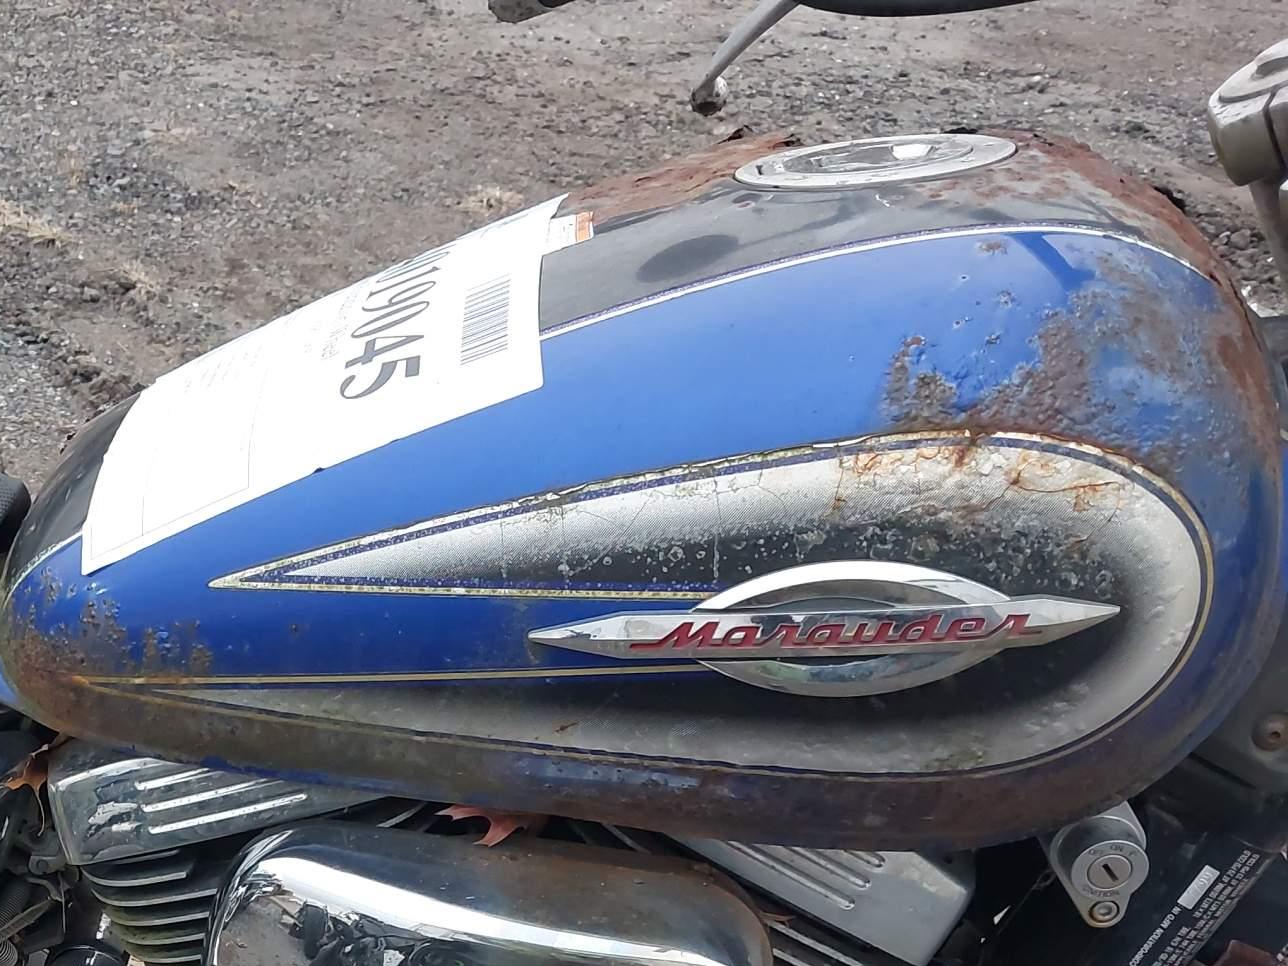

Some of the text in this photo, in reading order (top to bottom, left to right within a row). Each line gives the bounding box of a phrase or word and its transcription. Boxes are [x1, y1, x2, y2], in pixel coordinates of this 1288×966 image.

[628, 611, 1043, 651] Marauder
[1129, 928, 1164, 966] CORPORATION
[1160, 914, 1175, 929] MFD
